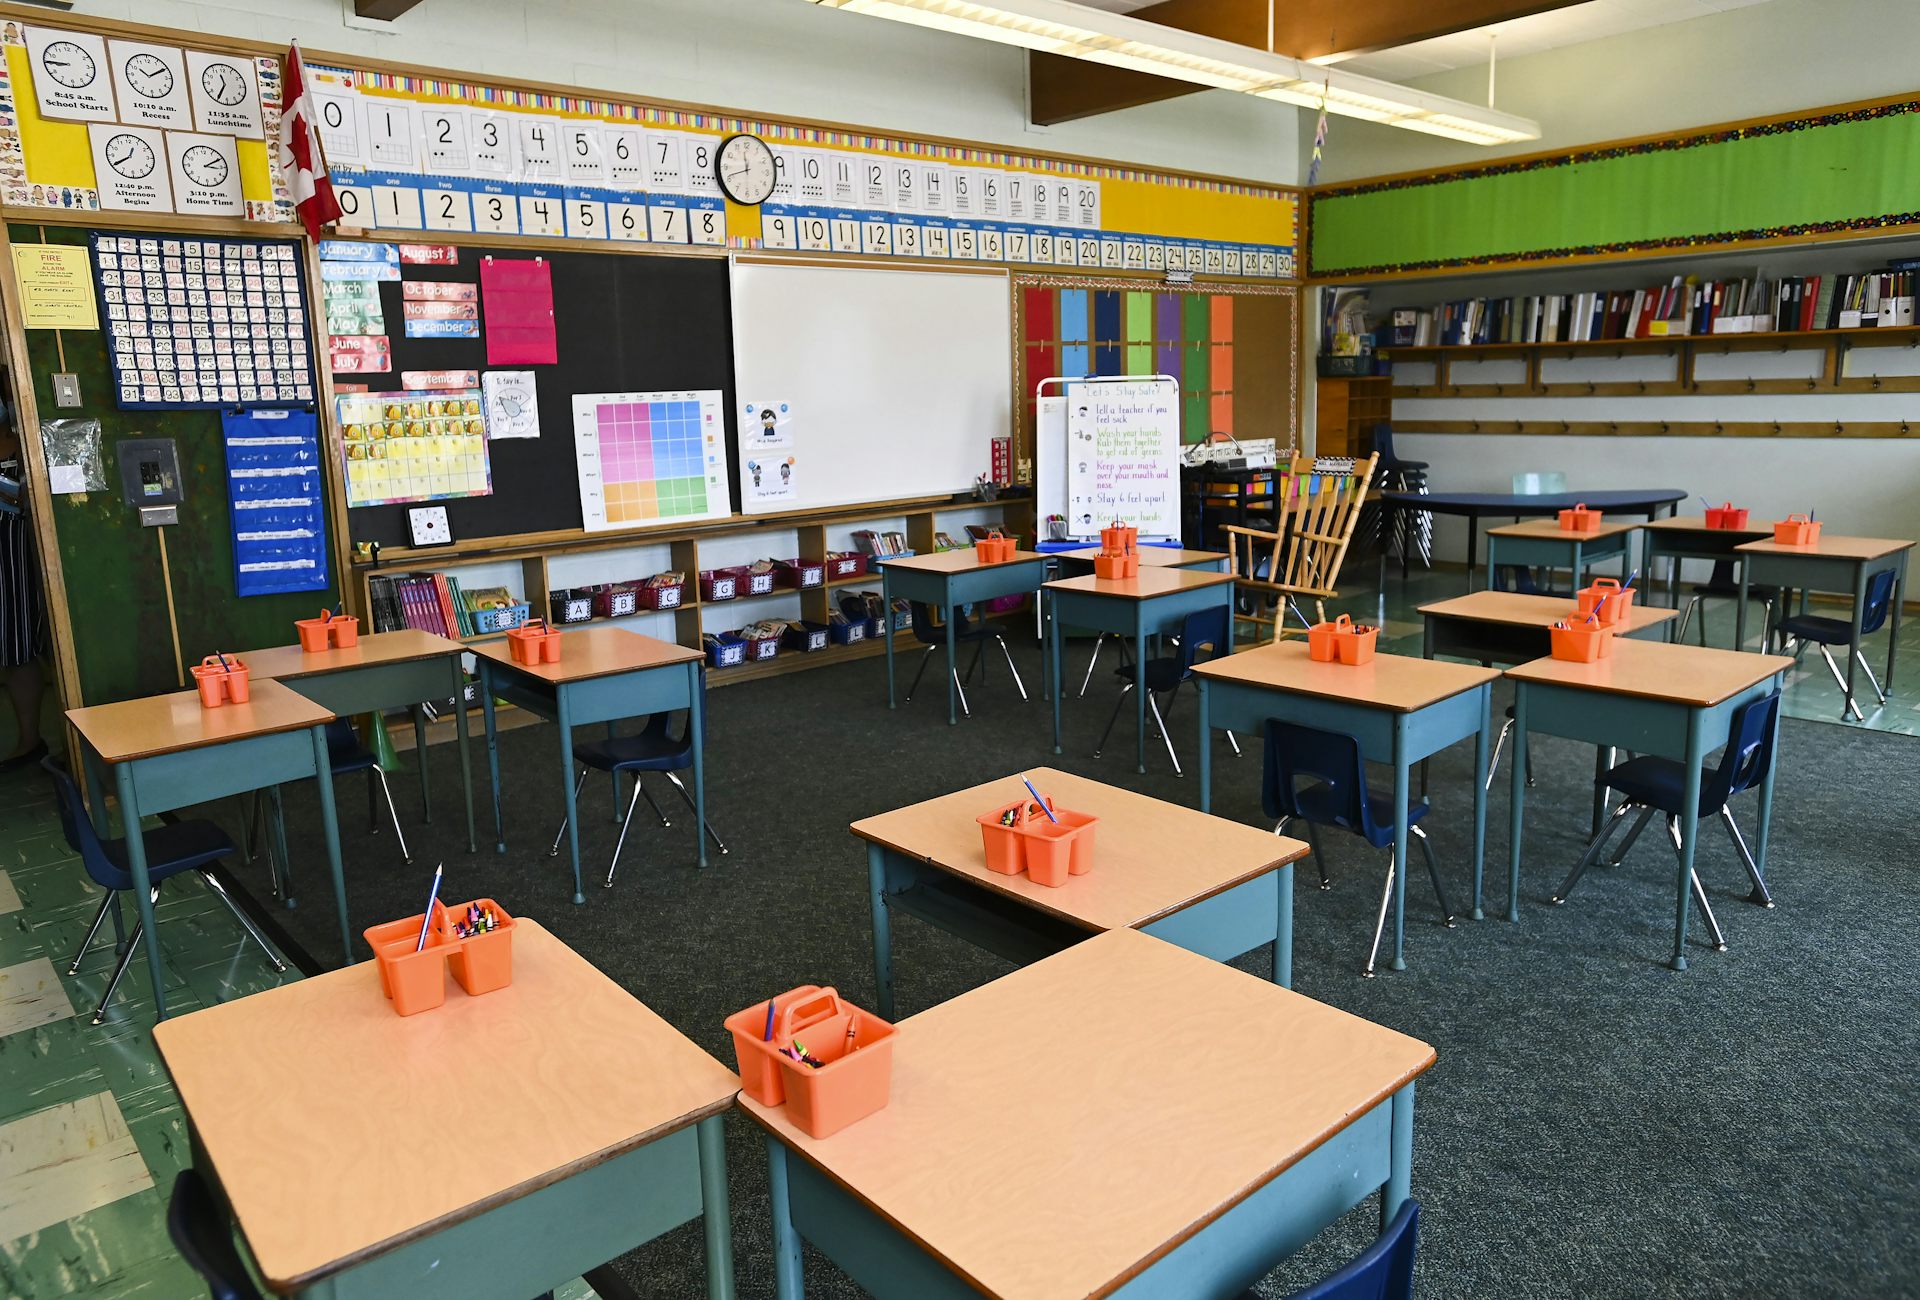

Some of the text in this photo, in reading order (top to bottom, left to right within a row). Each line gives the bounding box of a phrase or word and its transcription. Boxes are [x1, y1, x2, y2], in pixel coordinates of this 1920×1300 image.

[54, 91, 97, 102] 8:45 a.m.
[45, 99, 109, 112] School Starts
[133, 102, 177, 112] 10:10 a.m.
[141, 111, 171, 120] Recess
[208, 110, 230, 119] 11:35
[324, 101, 342, 128] 0
[207, 118, 252, 128] Lunchtime
[386, 112, 392, 138] 1
[436, 118, 453, 143] 2
[483, 122, 498, 147] 3
[532, 127, 545, 151] 4
[576, 133, 589, 156] 5
[616, 137, 629, 160] 6
[657, 142, 668, 164] 7
[696, 146, 708, 168] 8
[343, 164, 353, 172] by
[774, 155, 786, 177] 9
[802, 158, 819, 179] 10
[838, 161, 849, 182] 11
[337, 177, 355, 185] zero
[868, 165, 882, 185] 12
[898, 168, 912, 188] 13
[927, 172, 940, 191] 14
[114, 182, 135, 190] 12:40
[438, 181, 453, 189] two
[485, 185, 502, 193] three
[533, 188, 547, 196] four
[955, 175, 968, 195] 15
[984, 178, 997, 197] 16
[1009, 181, 1020, 199] 17
[115, 190, 156, 198] Afternoon
[1034, 184, 1046, 202] 18
[1058, 186, 1069, 204] 19
[1079, 190, 1096, 208] 20
[124, 198, 150, 206] Begins
[186, 198, 211, 206] Home
[339, 190, 358, 215] 0
[392, 190, 398, 215] 1
[440, 194, 455, 218] 2
[488, 198, 502, 221] 3
[534, 201, 548, 224] 4
[580, 204, 594, 227] 5
[622, 207, 635, 230] 6
[663, 210, 674, 231] 7
[703, 213, 714, 234] 8
[773, 218, 785, 239] 9
[804, 220, 824, 240] 10
[839, 222, 854, 242] 11
[869, 225, 886, 245] 12
[899, 227, 915, 247] 13
[928, 230, 943, 248] 14
[956, 231, 972, 250] 15
[984, 233, 998, 252] 16
[1010, 235, 1024, 253] 17
[168, 244, 175, 253] 4
[189, 245, 196, 254] 5
[209, 246, 216, 255] 6
[228, 247, 236, 256] 7
[246, 247, 252, 257] 8
[321, 244, 373, 257] January
[402, 246, 444, 261] August
[1035, 237, 1048, 255] 18
[1060, 239, 1072, 256] 19
[1081, 241, 1097, 258] 20
[1107, 243, 1119, 260] 21
[1127, 244, 1142, 261] 22
[41, 254, 62, 262] FIRE
[1149, 246, 1162, 263] 23
[1168, 248, 1182, 265] 24
[1189, 249, 1202, 266] 25
[1208, 251, 1221, 267] 26
[1226, 252, 1238, 268] 27
[1245, 253, 1257, 270] 28
[1262, 254, 1273, 269] 29
[187, 261, 201, 270] 15
[322, 263, 380, 277] February
[1278, 256, 1291, 271] 30
[107, 290, 120, 300] 31
[323, 282, 362, 295] March
[405, 283, 454, 294] October
[329, 301, 359, 315] April
[406, 302, 461, 315] November
[194, 327, 208, 336] 55
[331, 317, 359, 331] May
[407, 320, 464, 332] December
[332, 337, 361, 349] June
[333, 356, 360, 370] July
[124, 373, 137, 383] 81
[404, 372, 466, 385] September
[123, 389, 137, 399] 91
[1117, 386, 1136, 399] Stay
[1096, 403, 1108, 414] Tell
[1119, 403, 1143, 414] teacher
[1156, 407, 1167, 415] you
[1096, 415, 1127, 423] feel sick
[1097, 427, 1162, 440] Wash your hands
[1097, 437, 1161, 449] Rub them together
[1097, 460, 1157, 473] Keep your mask
[1115, 472, 1130, 483] your
[1132, 469, 1155, 479] mouth
[1156, 468, 1169, 479] and
[1097, 491, 1165, 507] Stay 6 feet apart
[1140, 512, 1162, 521] hands
[721, 584, 729, 593] G
[757, 578, 765, 588] H
[619, 599, 627, 609] B
[666, 592, 673, 603] C
[574, 604, 582, 615] A
[854, 628, 859, 637] L
[730, 651, 735, 660] J
[764, 644, 771, 654] K
